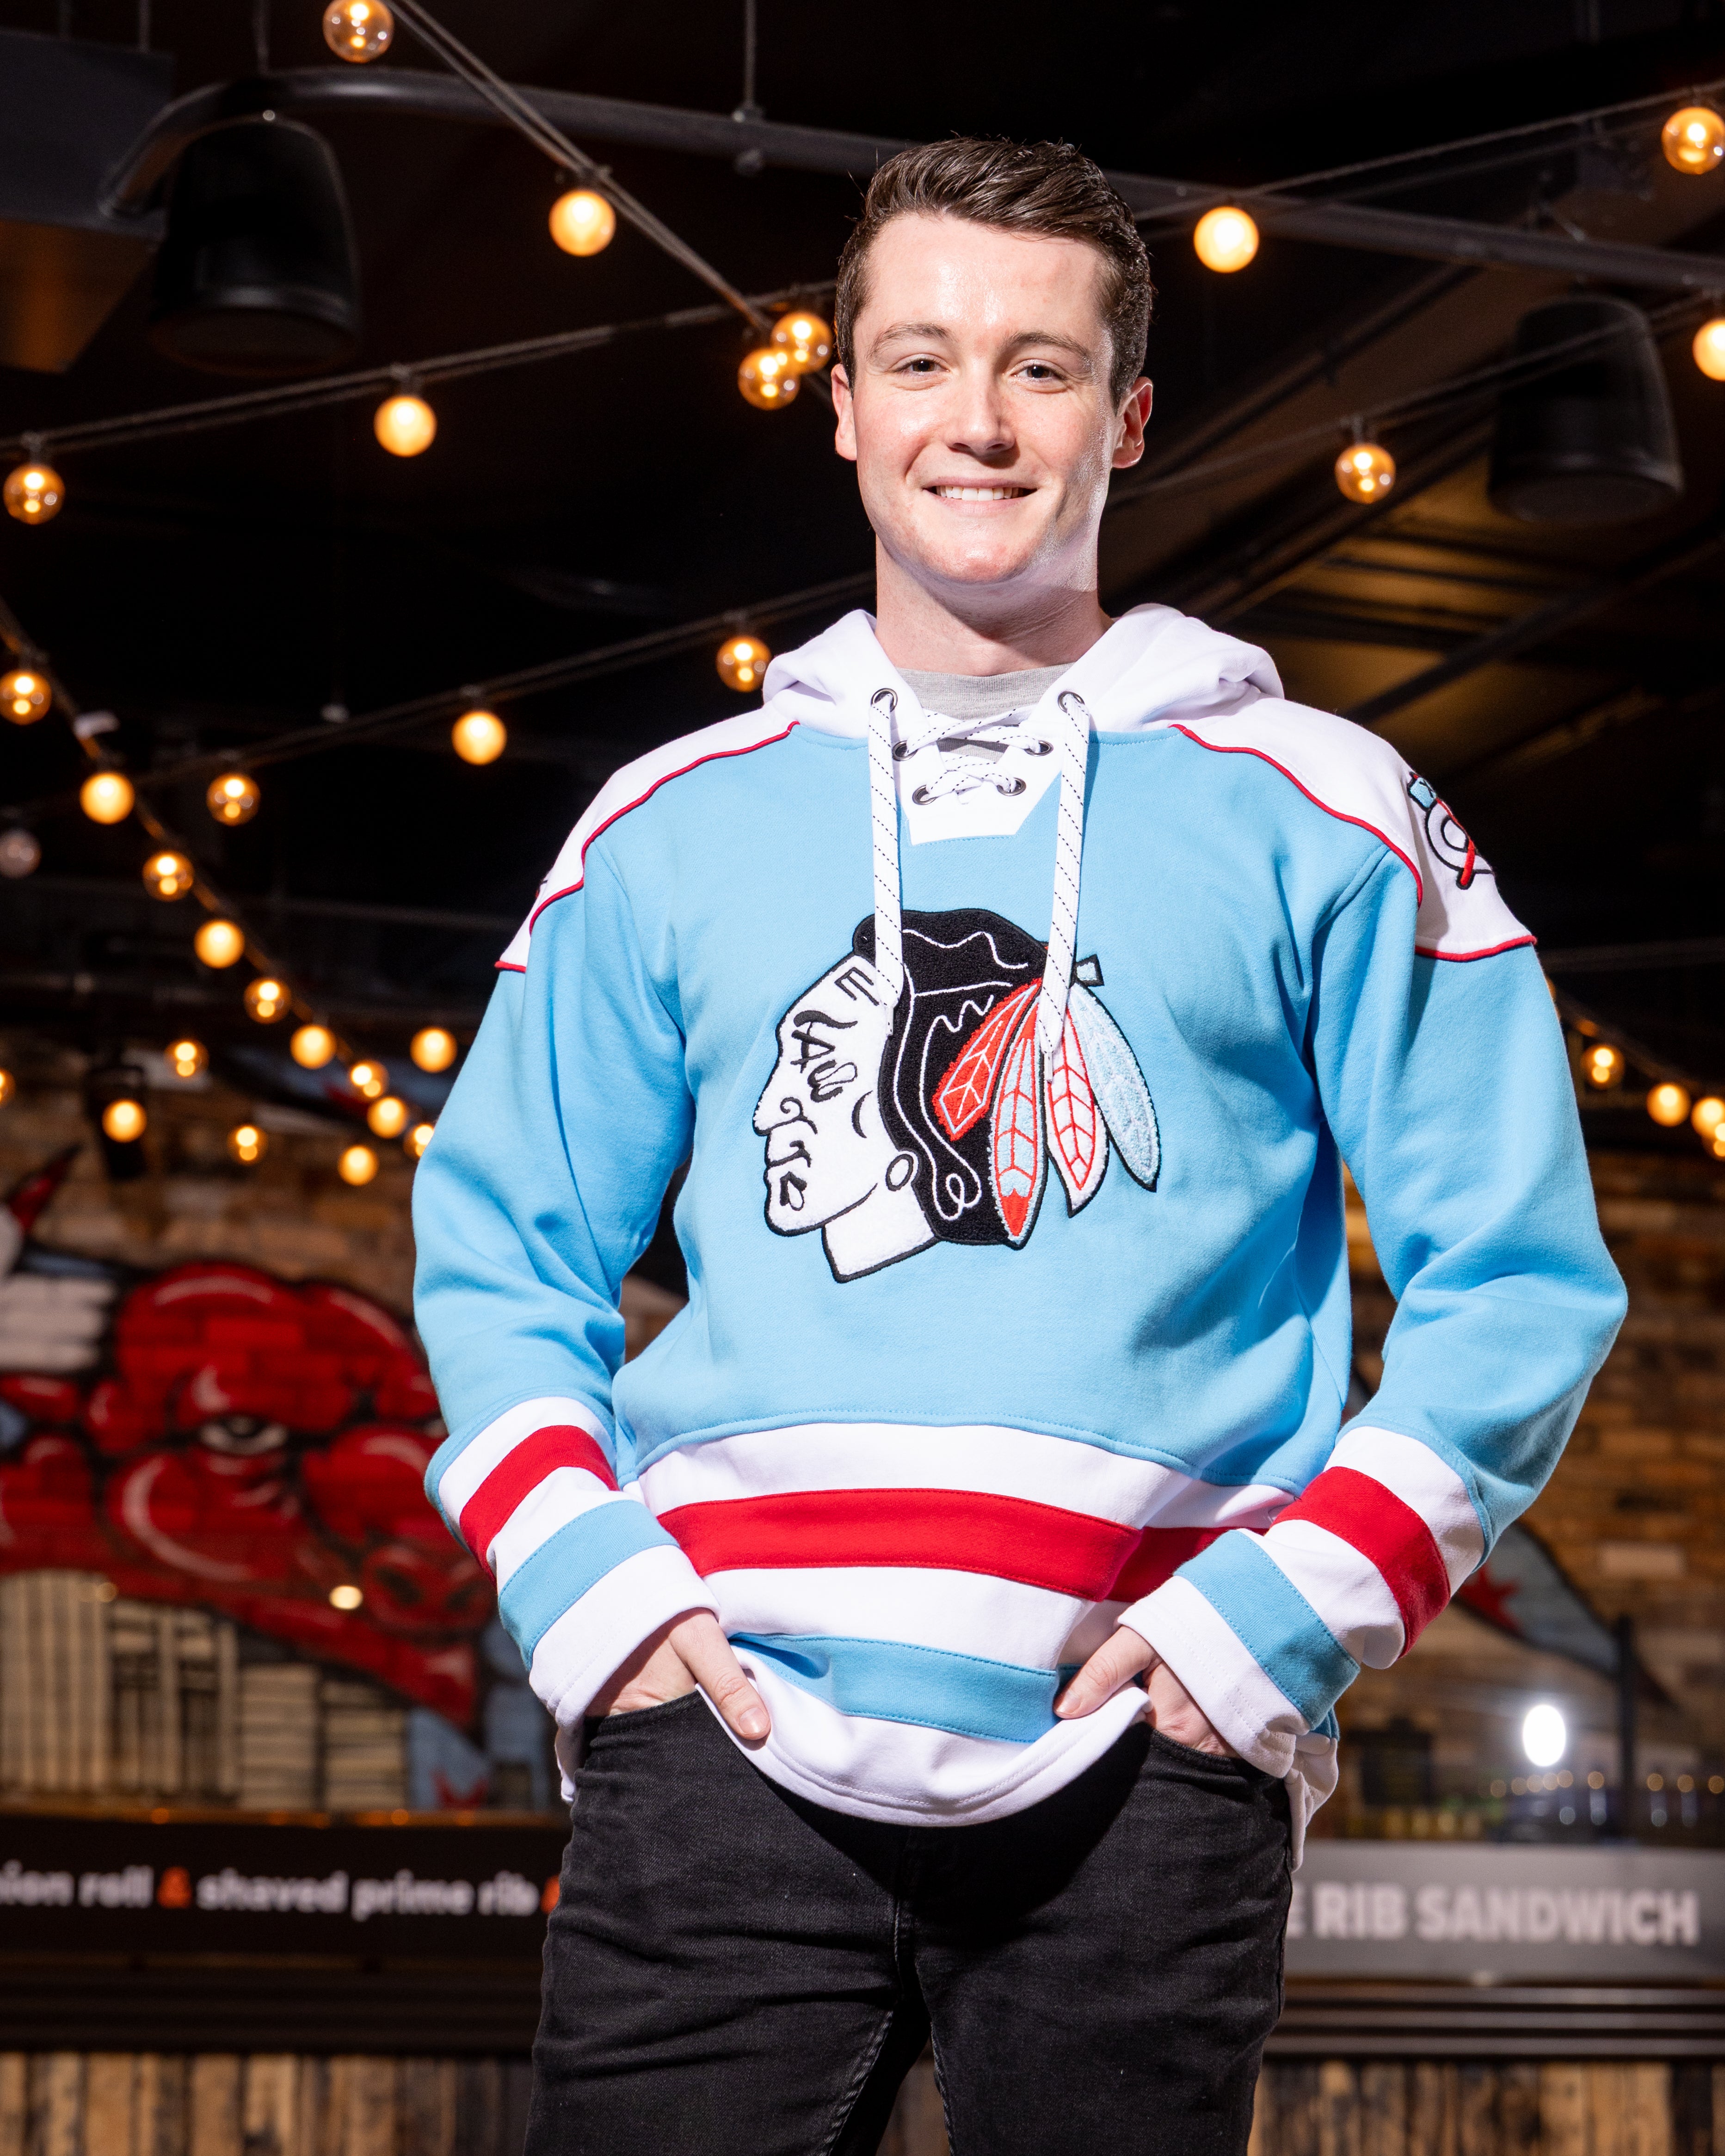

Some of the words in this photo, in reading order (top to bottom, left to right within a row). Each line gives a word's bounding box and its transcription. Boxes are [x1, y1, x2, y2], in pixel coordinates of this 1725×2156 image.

[0, 1861, 73, 1905] ion
[80, 1866, 153, 1907] roll
[157, 1867, 191, 1908] &
[197, 1868, 348, 1912] shaved
[352, 1869, 474, 1921] prime
[478, 1871, 539, 1916] rib
[1313, 1882, 1407, 1939] RIB
[1415, 1884, 1699, 1945] SANDWICH
